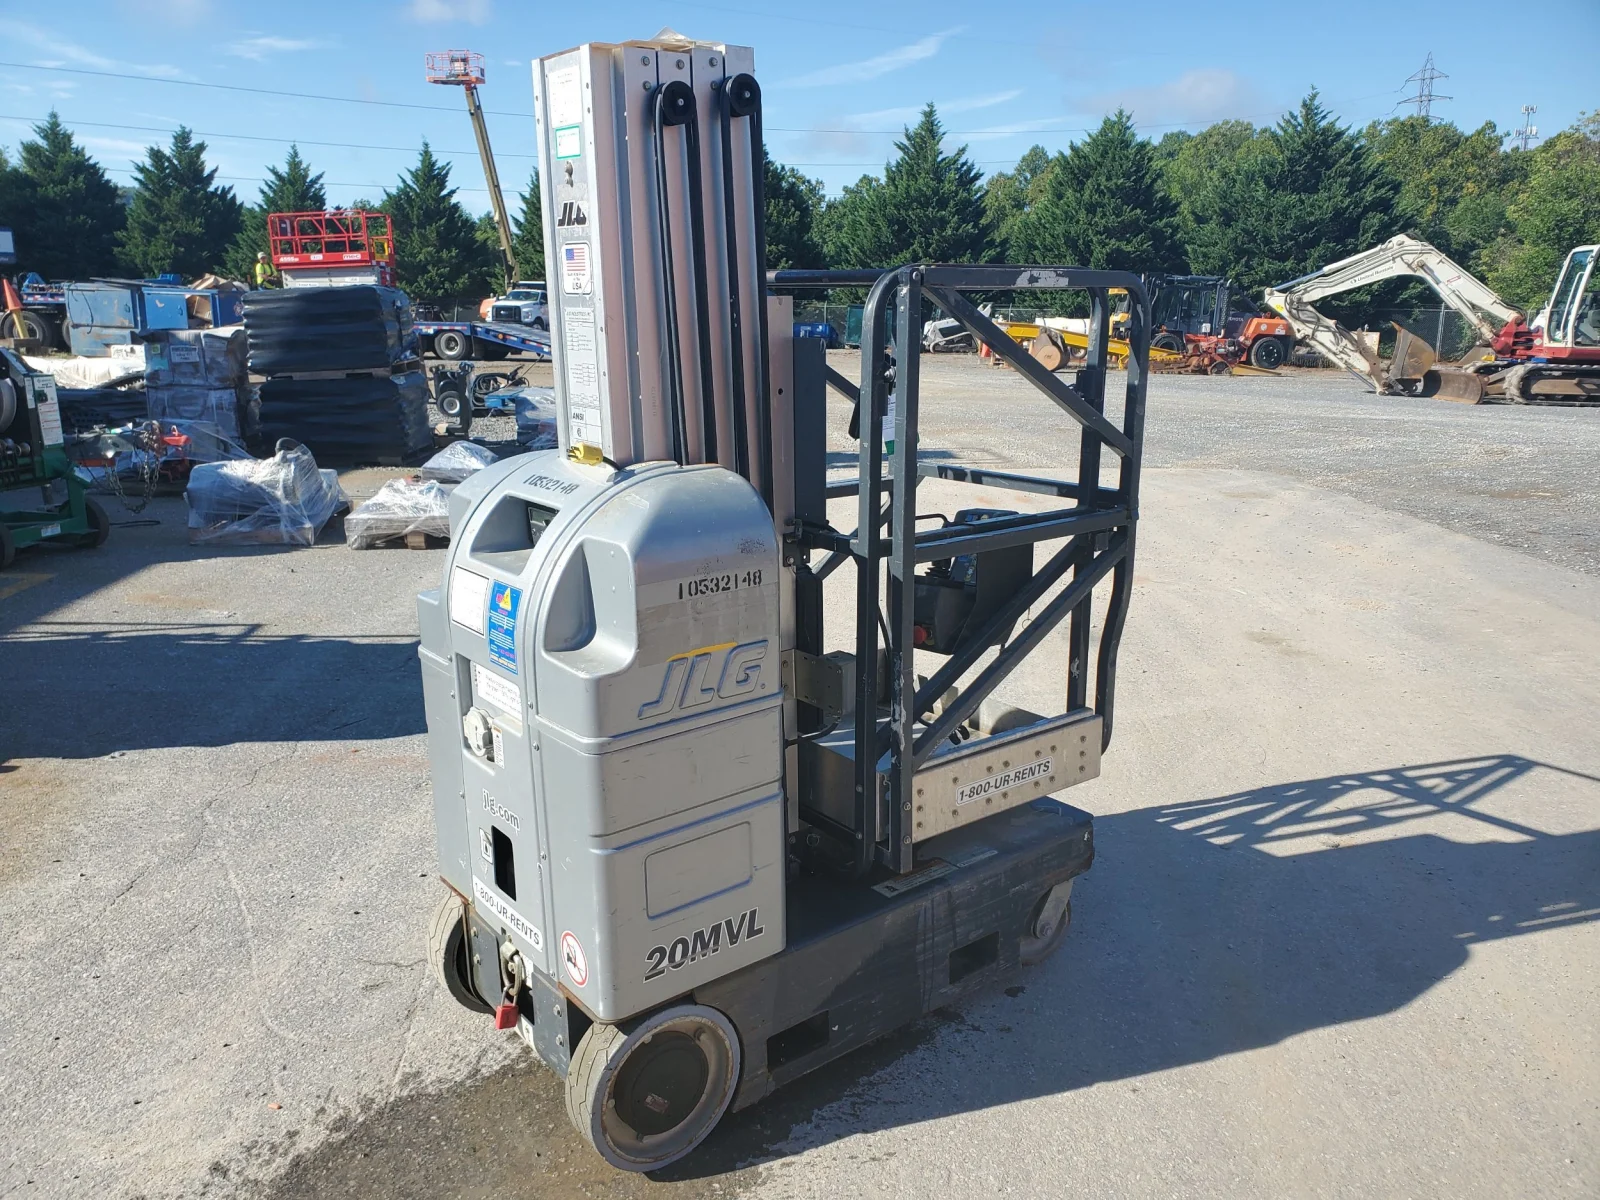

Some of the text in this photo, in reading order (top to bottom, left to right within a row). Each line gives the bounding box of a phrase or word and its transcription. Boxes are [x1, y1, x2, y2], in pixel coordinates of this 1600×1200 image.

[572, 412, 585, 421] ANSI
[523, 474, 580, 495] 10532148
[678, 569, 763, 600] 10532148
[637, 639, 769, 720] JLG
[958, 760, 1051, 802] 1-800-UR-RENTS
[483, 788, 520, 831] jlg.com
[474, 881, 540, 945] 1-800-UR-RENTS
[643, 907, 765, 984] 20MVL
